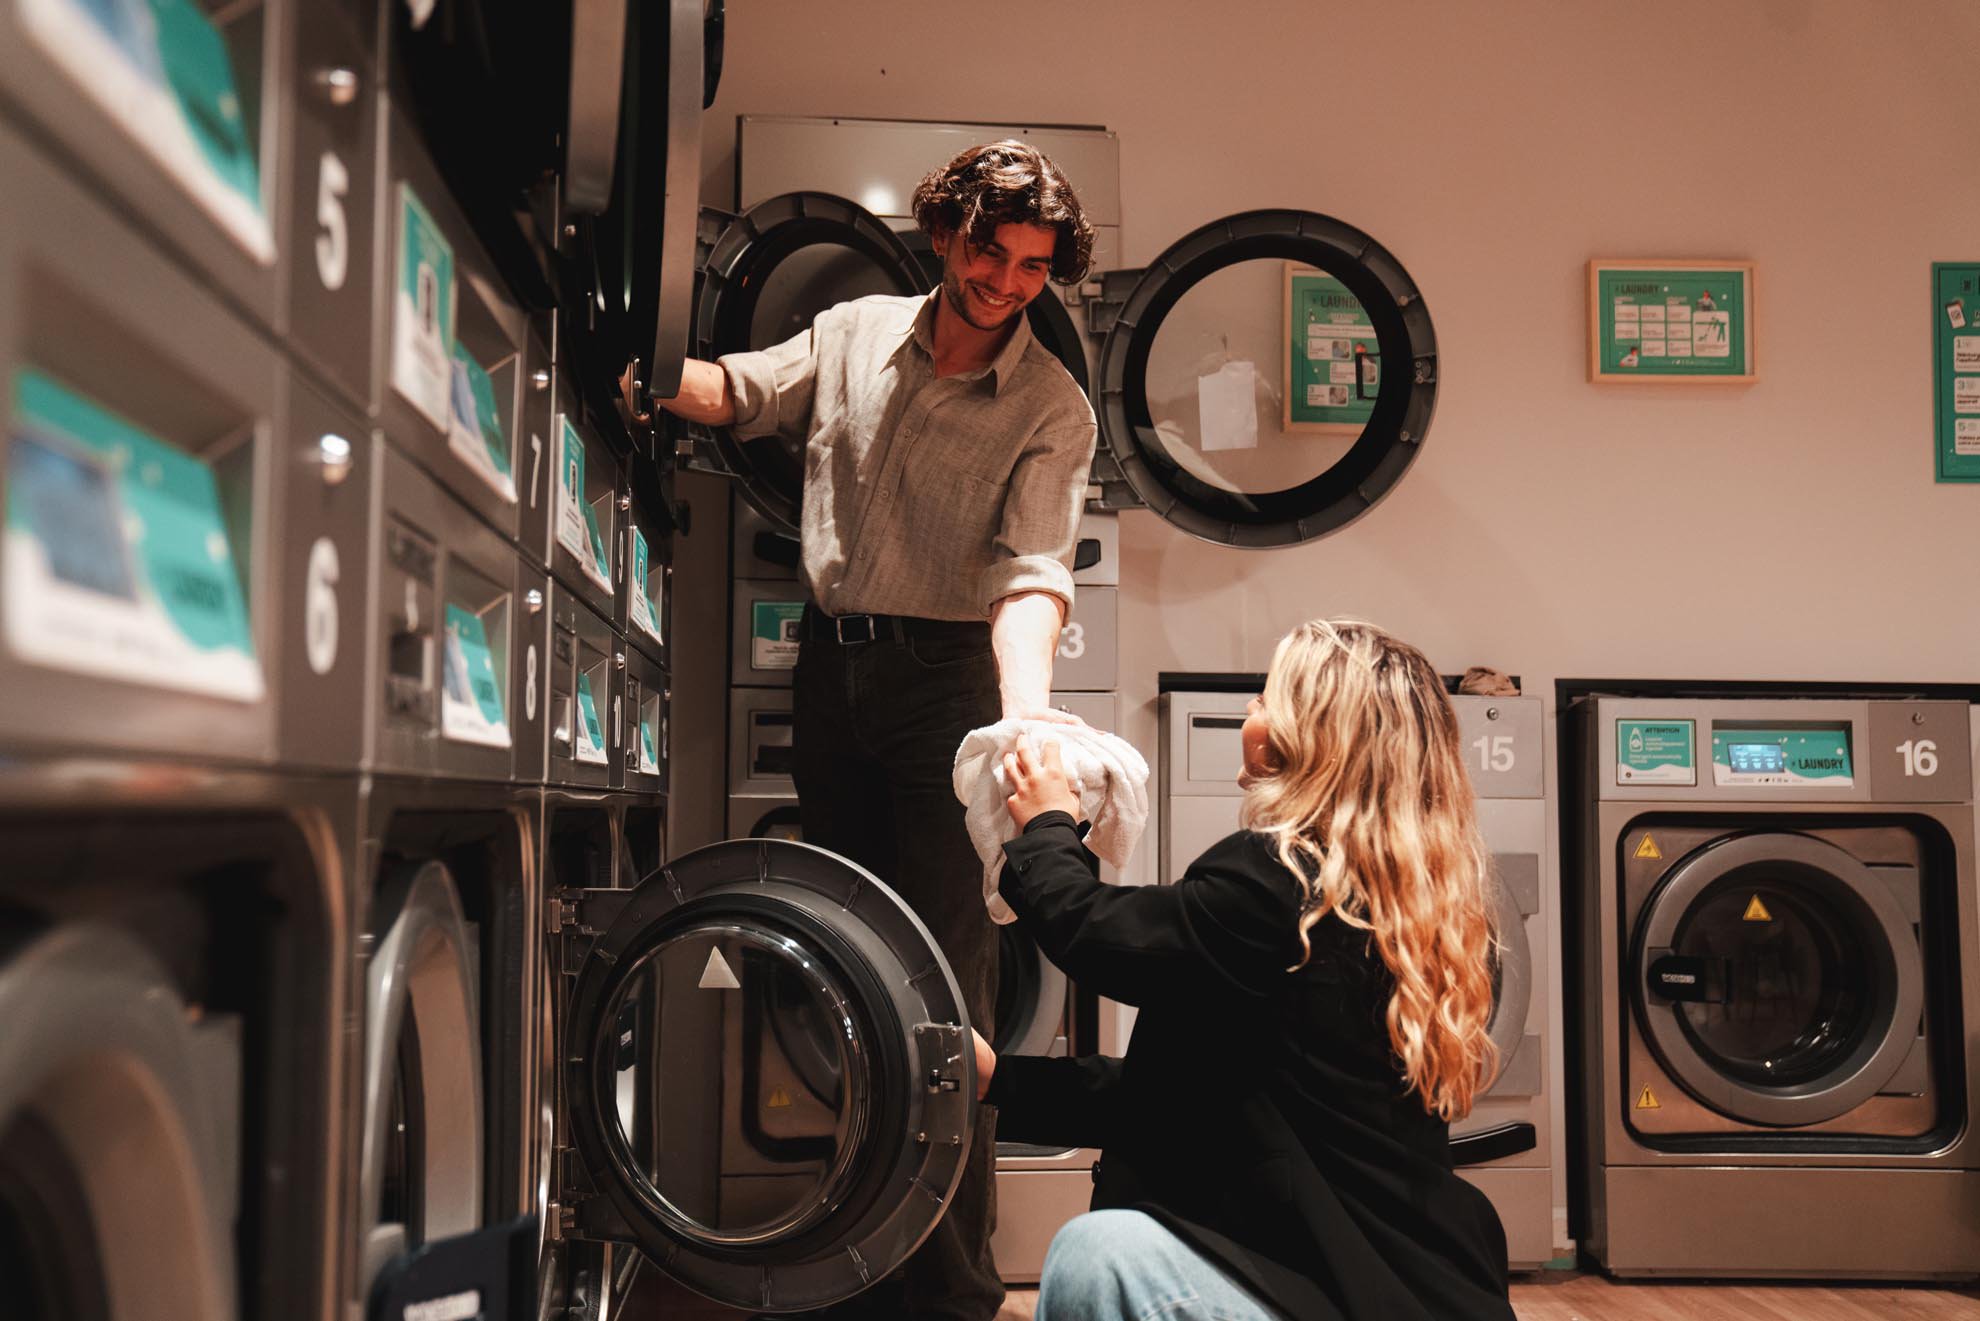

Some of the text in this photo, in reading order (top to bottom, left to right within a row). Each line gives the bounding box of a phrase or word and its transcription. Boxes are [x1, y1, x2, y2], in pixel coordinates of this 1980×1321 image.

[316, 152, 349, 291] 5
[1320, 295, 1361, 309] LAUND
[306, 537, 340, 675] 6
[1055, 622, 1086, 658] 3
[525, 645, 537, 721] 8
[1473, 736, 1515, 772] 15
[1799, 758, 1844, 770] LAUNDRY
[1895, 739, 1938, 777] 16
